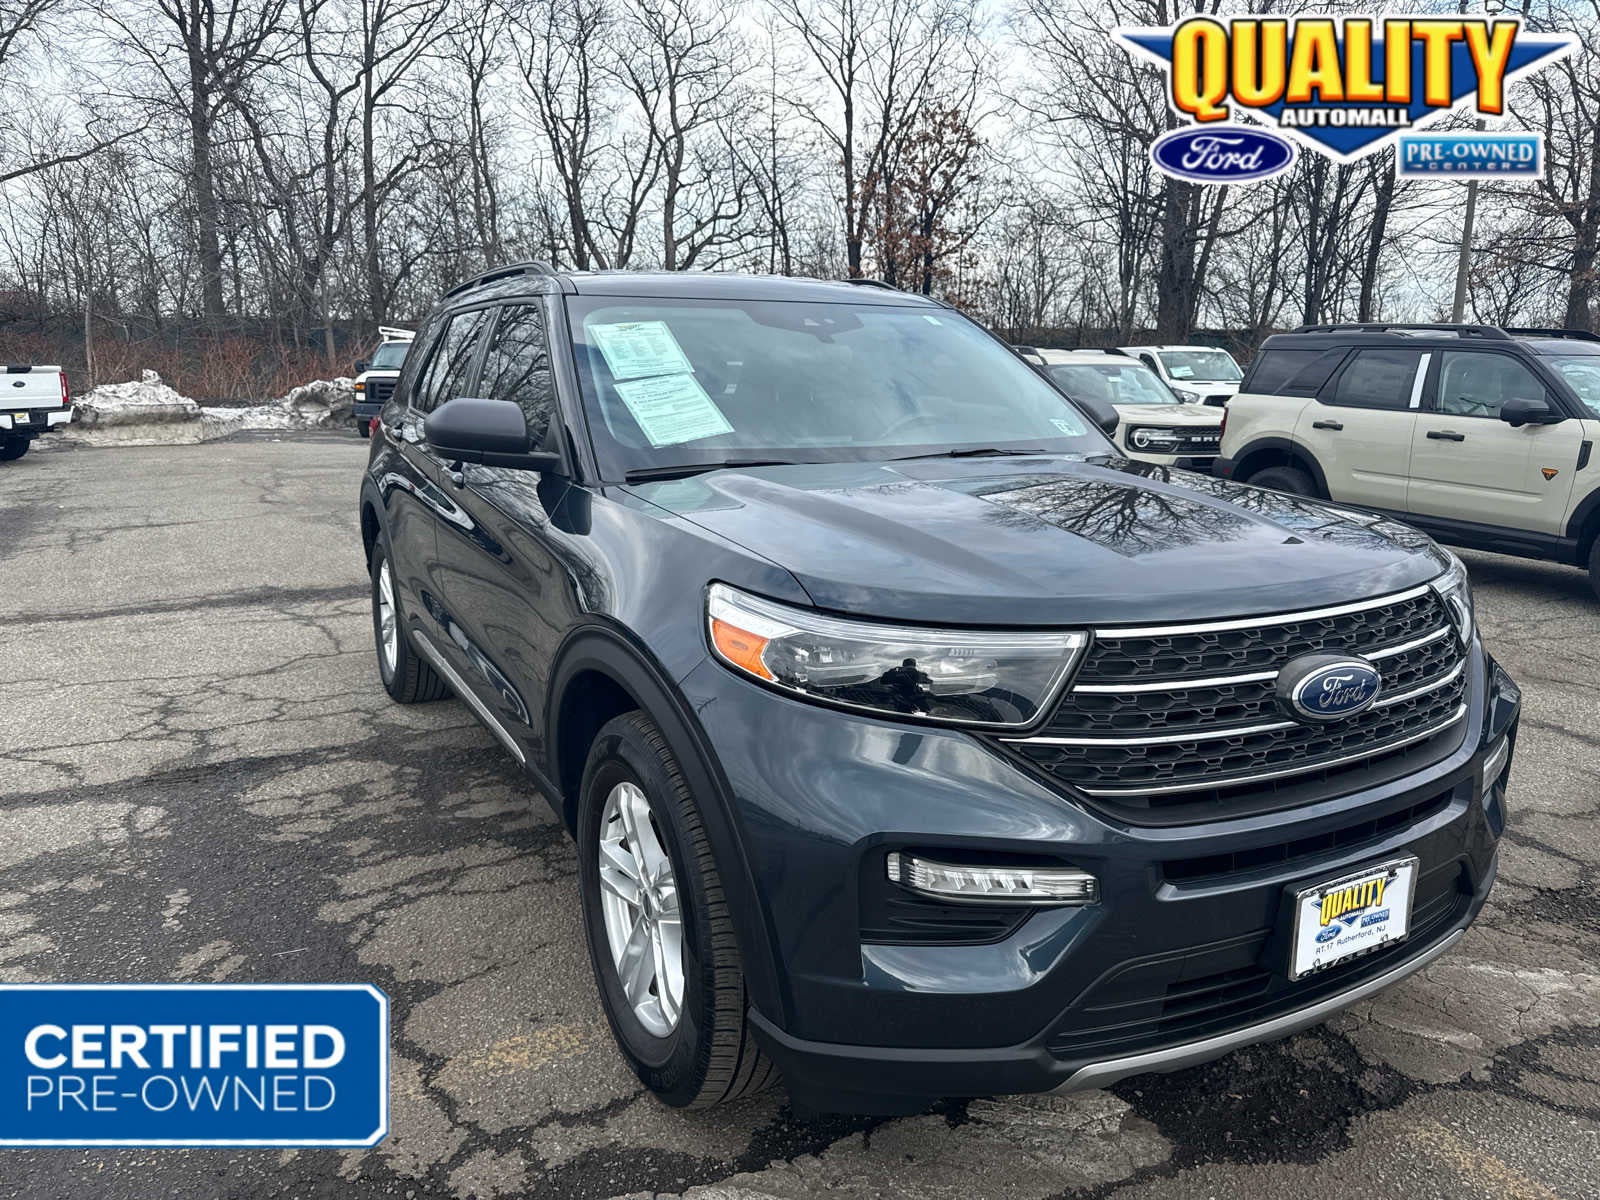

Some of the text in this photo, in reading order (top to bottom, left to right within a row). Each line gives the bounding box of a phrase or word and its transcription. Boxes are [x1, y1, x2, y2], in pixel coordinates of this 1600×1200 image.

[1319, 674, 1367, 708] Ford
[1321, 877, 1387, 926] QUALITY
[1338, 930, 1374, 945] Rutherford,
[1376, 925, 1386, 933] NJ
